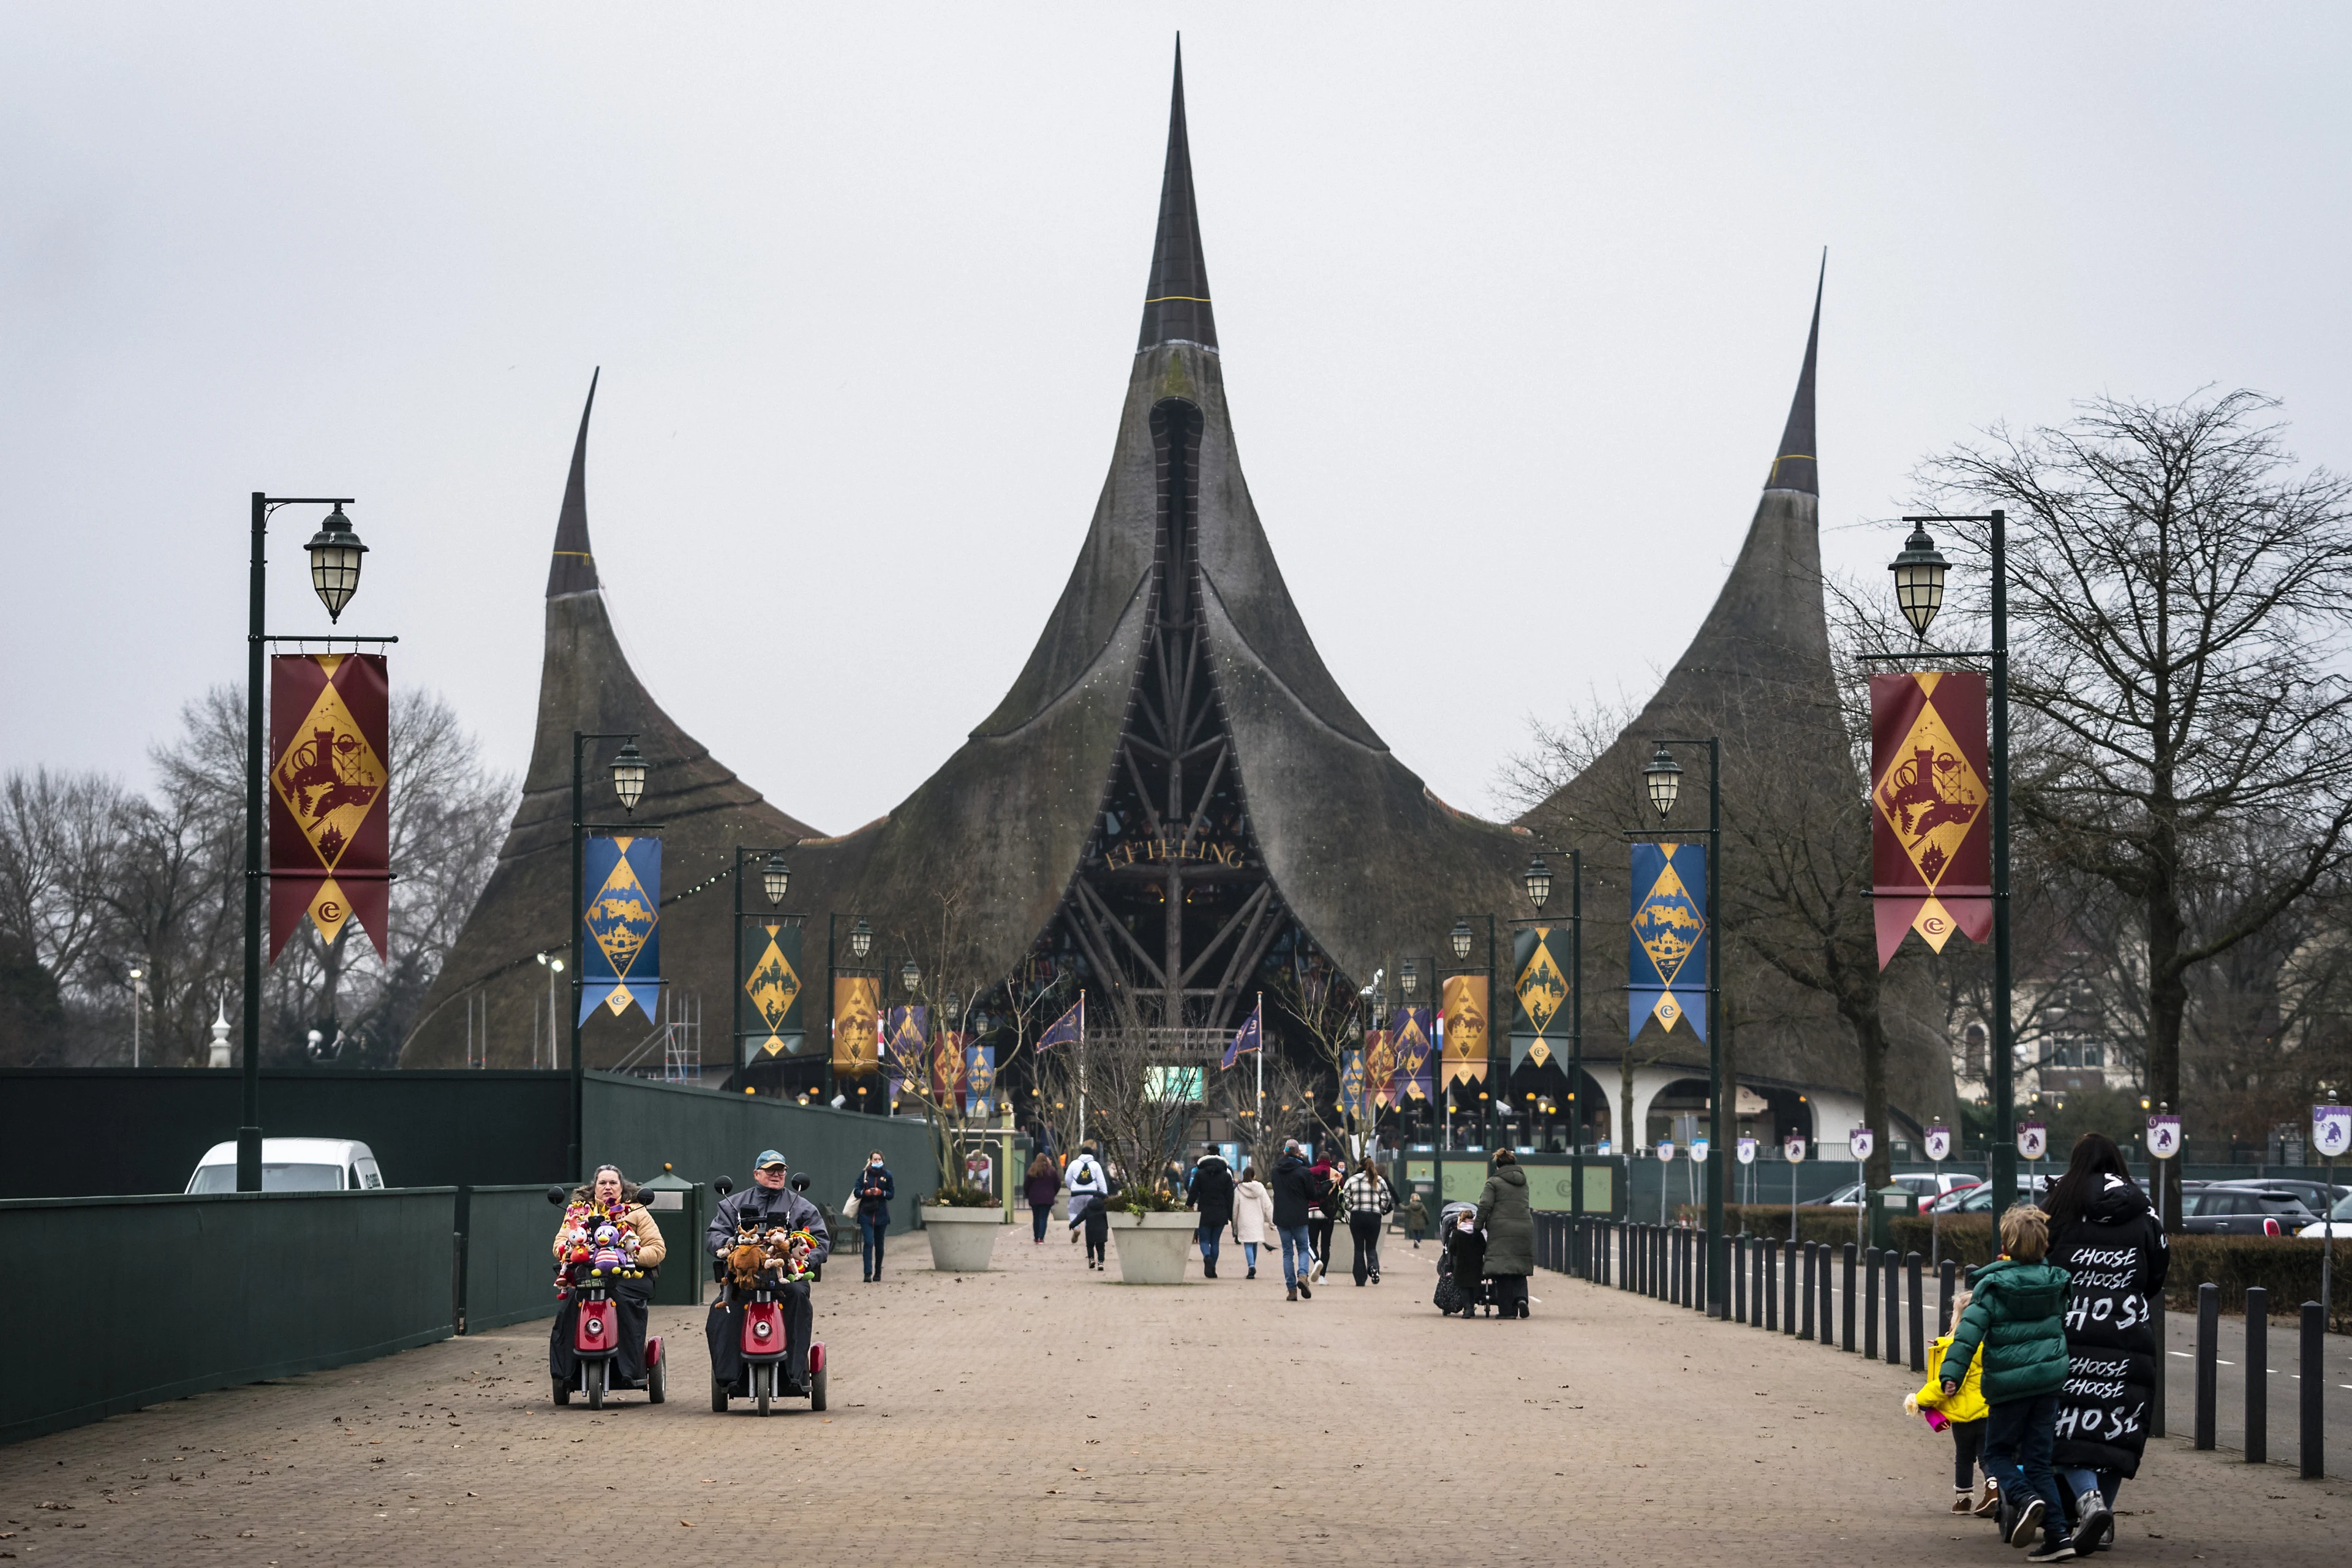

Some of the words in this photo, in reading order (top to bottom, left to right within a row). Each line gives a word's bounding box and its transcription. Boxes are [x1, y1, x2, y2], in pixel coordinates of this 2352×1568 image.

[2149, 1116, 2157, 1126] 6
[2316, 1106, 2324, 1118] 7
[2019, 1122, 2026, 1132] 5
[2070, 1248, 2137, 1268] CHOOSE
[2072, 1269, 2137, 1290] CHOOSE
[2065, 1292, 2150, 1332] HOSE
[2062, 1379, 2125, 1399] CHOOSE
[2054, 1401, 2145, 1441] HOSE
